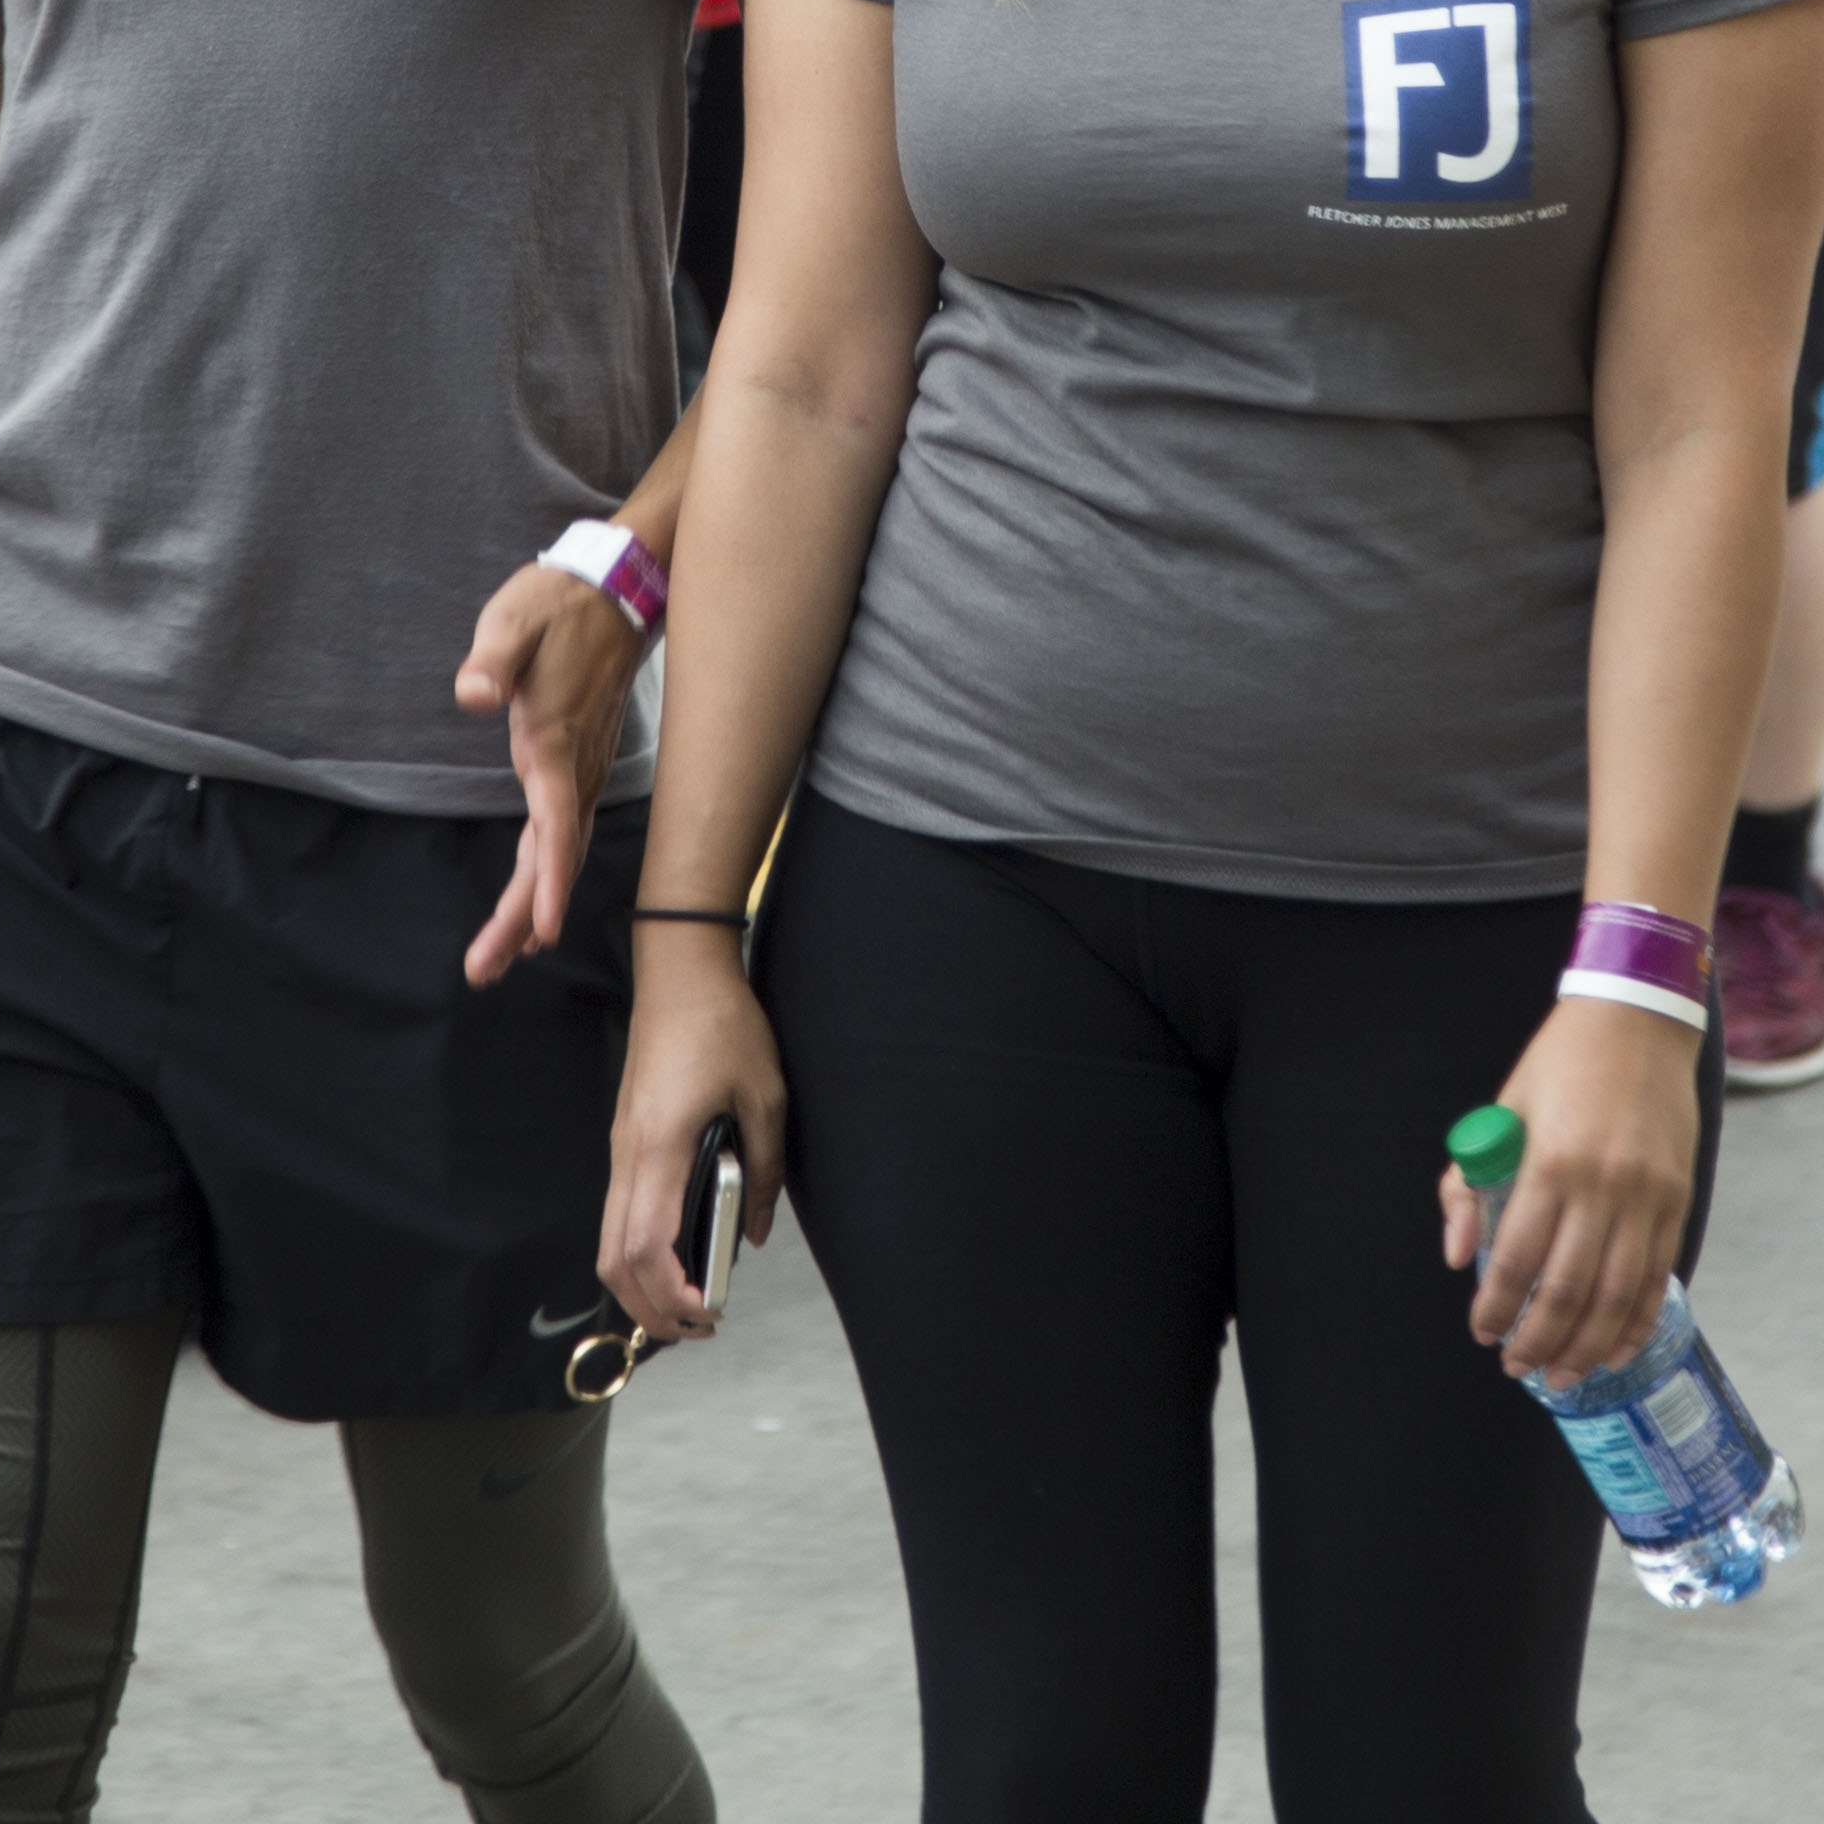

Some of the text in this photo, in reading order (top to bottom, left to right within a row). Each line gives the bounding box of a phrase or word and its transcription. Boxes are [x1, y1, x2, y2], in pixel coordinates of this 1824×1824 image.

[1358, 2, 1521, 184] FJ
[1307, 201, 1569, 231] FLETCHER JONES MANAGEMENT WEST
